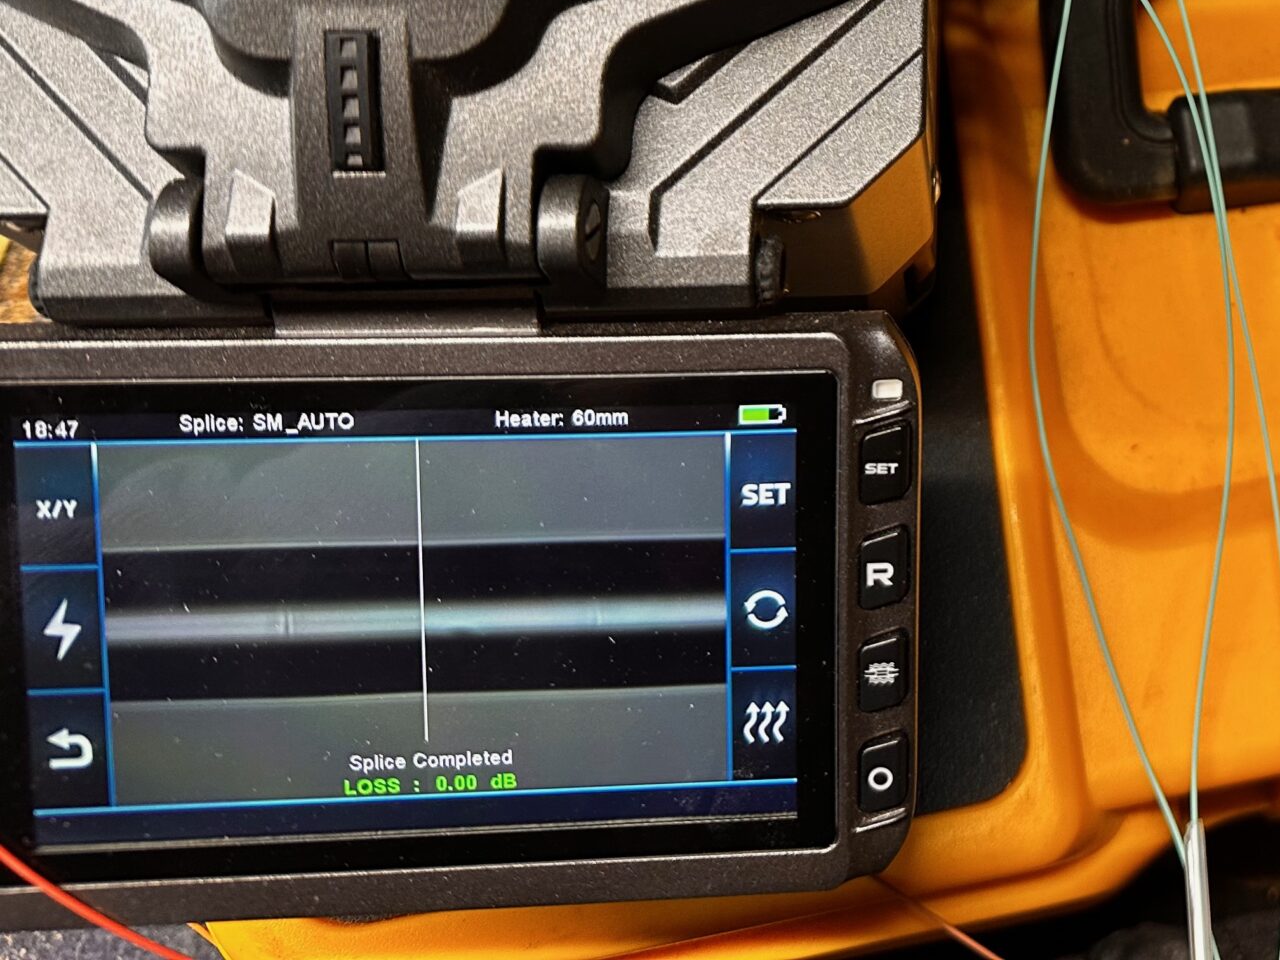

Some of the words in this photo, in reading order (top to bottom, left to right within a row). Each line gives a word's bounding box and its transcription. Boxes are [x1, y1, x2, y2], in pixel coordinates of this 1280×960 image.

[22, 420, 79, 439] 18:47
[179, 414, 244, 434] Splice:
[252, 412, 355, 435] SM_AUTO
[494, 410, 564, 428] Heater:
[571, 409, 629, 426] 60mm
[864, 462, 899, 475] SET
[740, 482, 792, 506] SET
[36, 500, 78, 520] X/Y
[866, 562, 894, 587] R
[349, 754, 407, 775] Splice
[412, 749, 513, 772] Completed
[343, 777, 401, 796] LOSS
[435, 775, 478, 791] 0.00
[490, 772, 518, 790] dB
